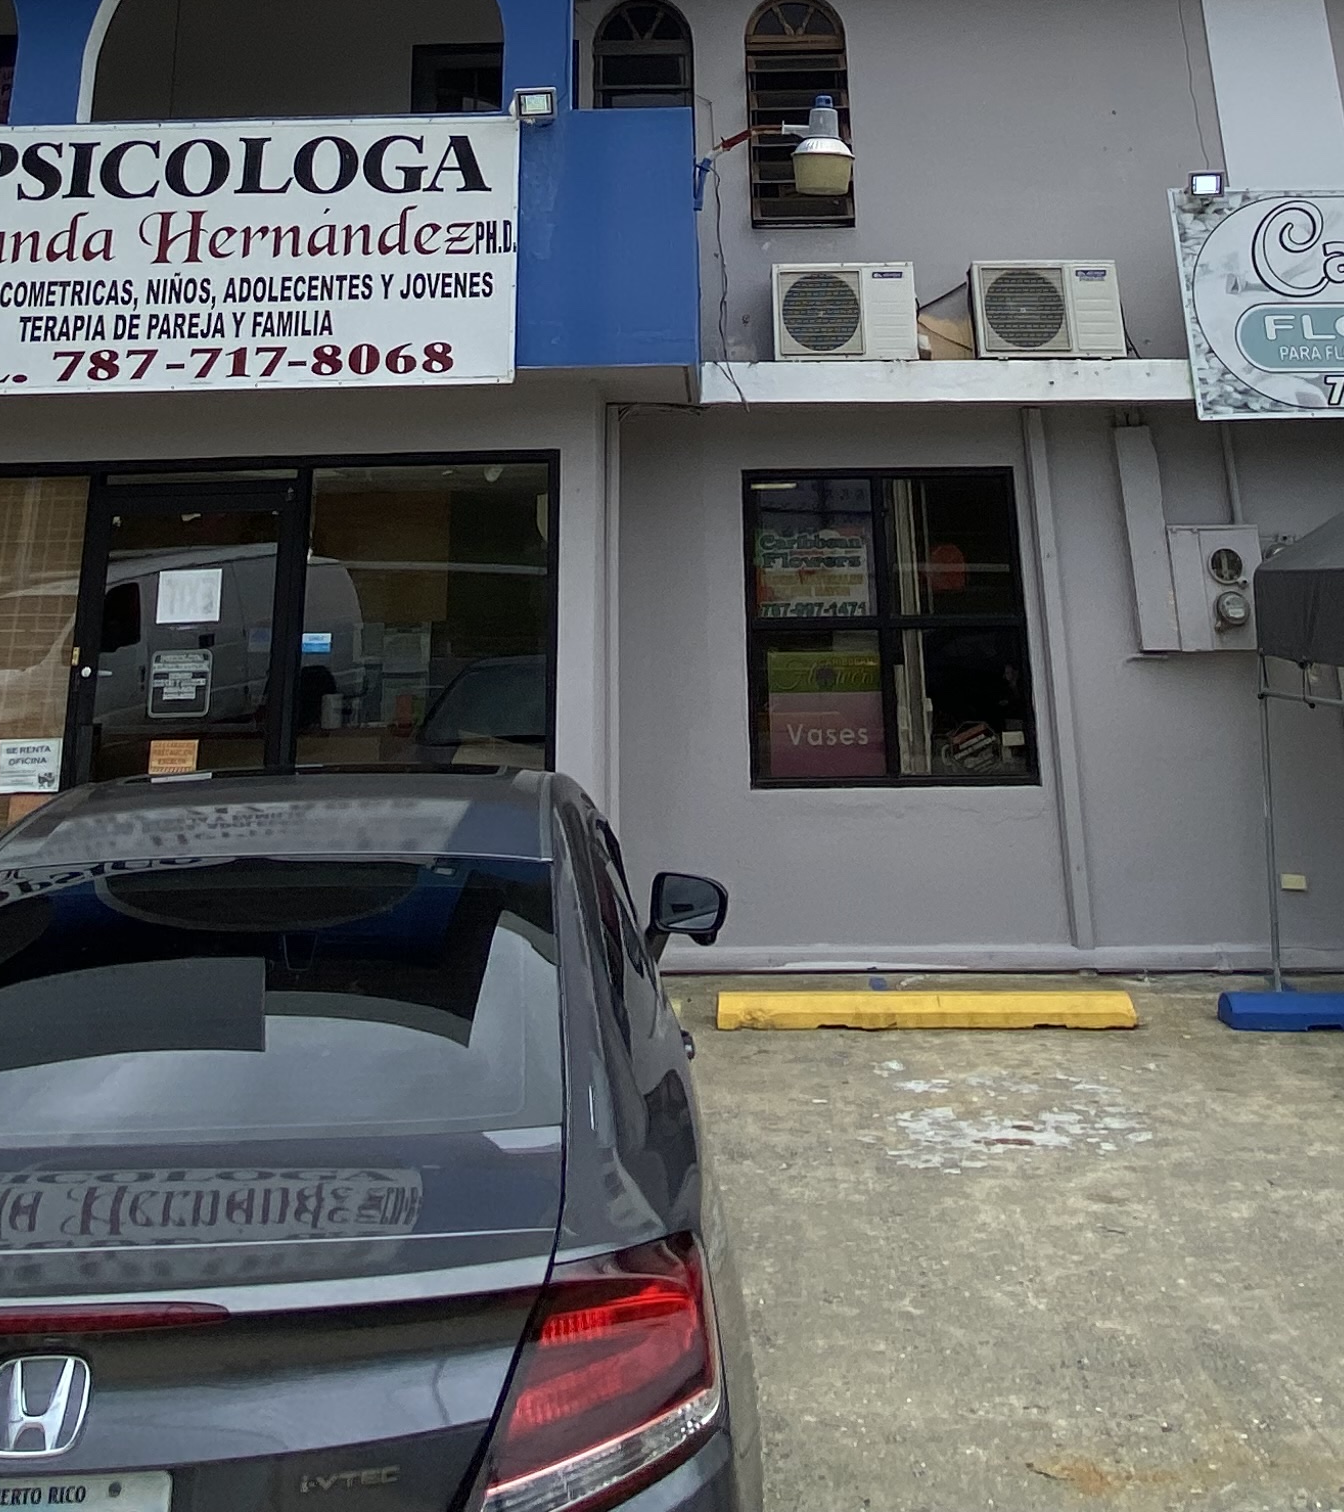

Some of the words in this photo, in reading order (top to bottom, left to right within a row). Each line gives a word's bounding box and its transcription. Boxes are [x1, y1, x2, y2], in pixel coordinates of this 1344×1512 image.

[139, 205, 475, 265] Hernández
[474, 220, 517, 256] PH.D.
[146, 272, 216, 306] NIÑOS,
[223, 274, 372, 302] ADOLECENTES
[381, 274, 393, 300] Y
[399, 272, 493, 299] JOVENES
[20, 314, 106, 342] TERAPIA
[113, 314, 141, 340] DE
[146, 312, 227, 340] PAREJA
[231, 312, 245, 338] Y
[252, 310, 333, 337] FAMILIA
[52, 342, 455, 382] 787-717-8068
[1279, 346, 1321, 361] PARA
[786, 724, 869, 746] Vases
[20, 745, 51, 754] RENTA
[8, 756, 47, 766] OFICINA
[49, 1487, 87, 1506] RICO
